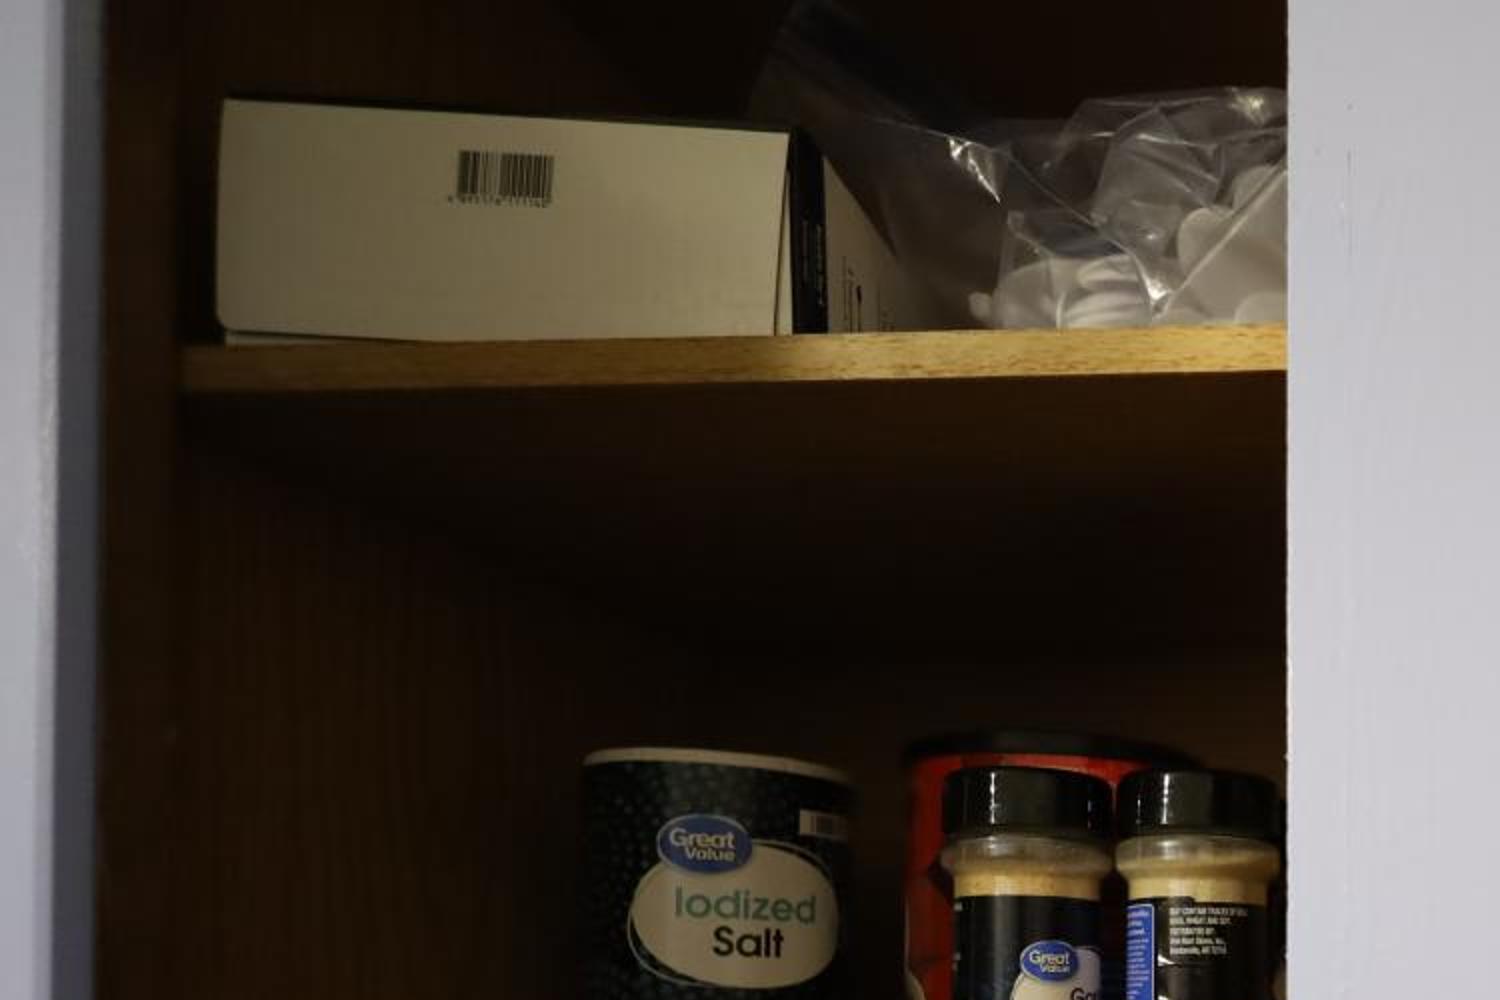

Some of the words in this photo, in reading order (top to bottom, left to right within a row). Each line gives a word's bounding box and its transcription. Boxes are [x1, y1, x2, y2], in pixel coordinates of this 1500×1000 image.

[669, 827, 736, 849] Great
[683, 846, 736, 862] Value
[676, 887, 817, 924] Iodized
[712, 926, 785, 958] Salt
[1029, 950, 1070, 965] Great
